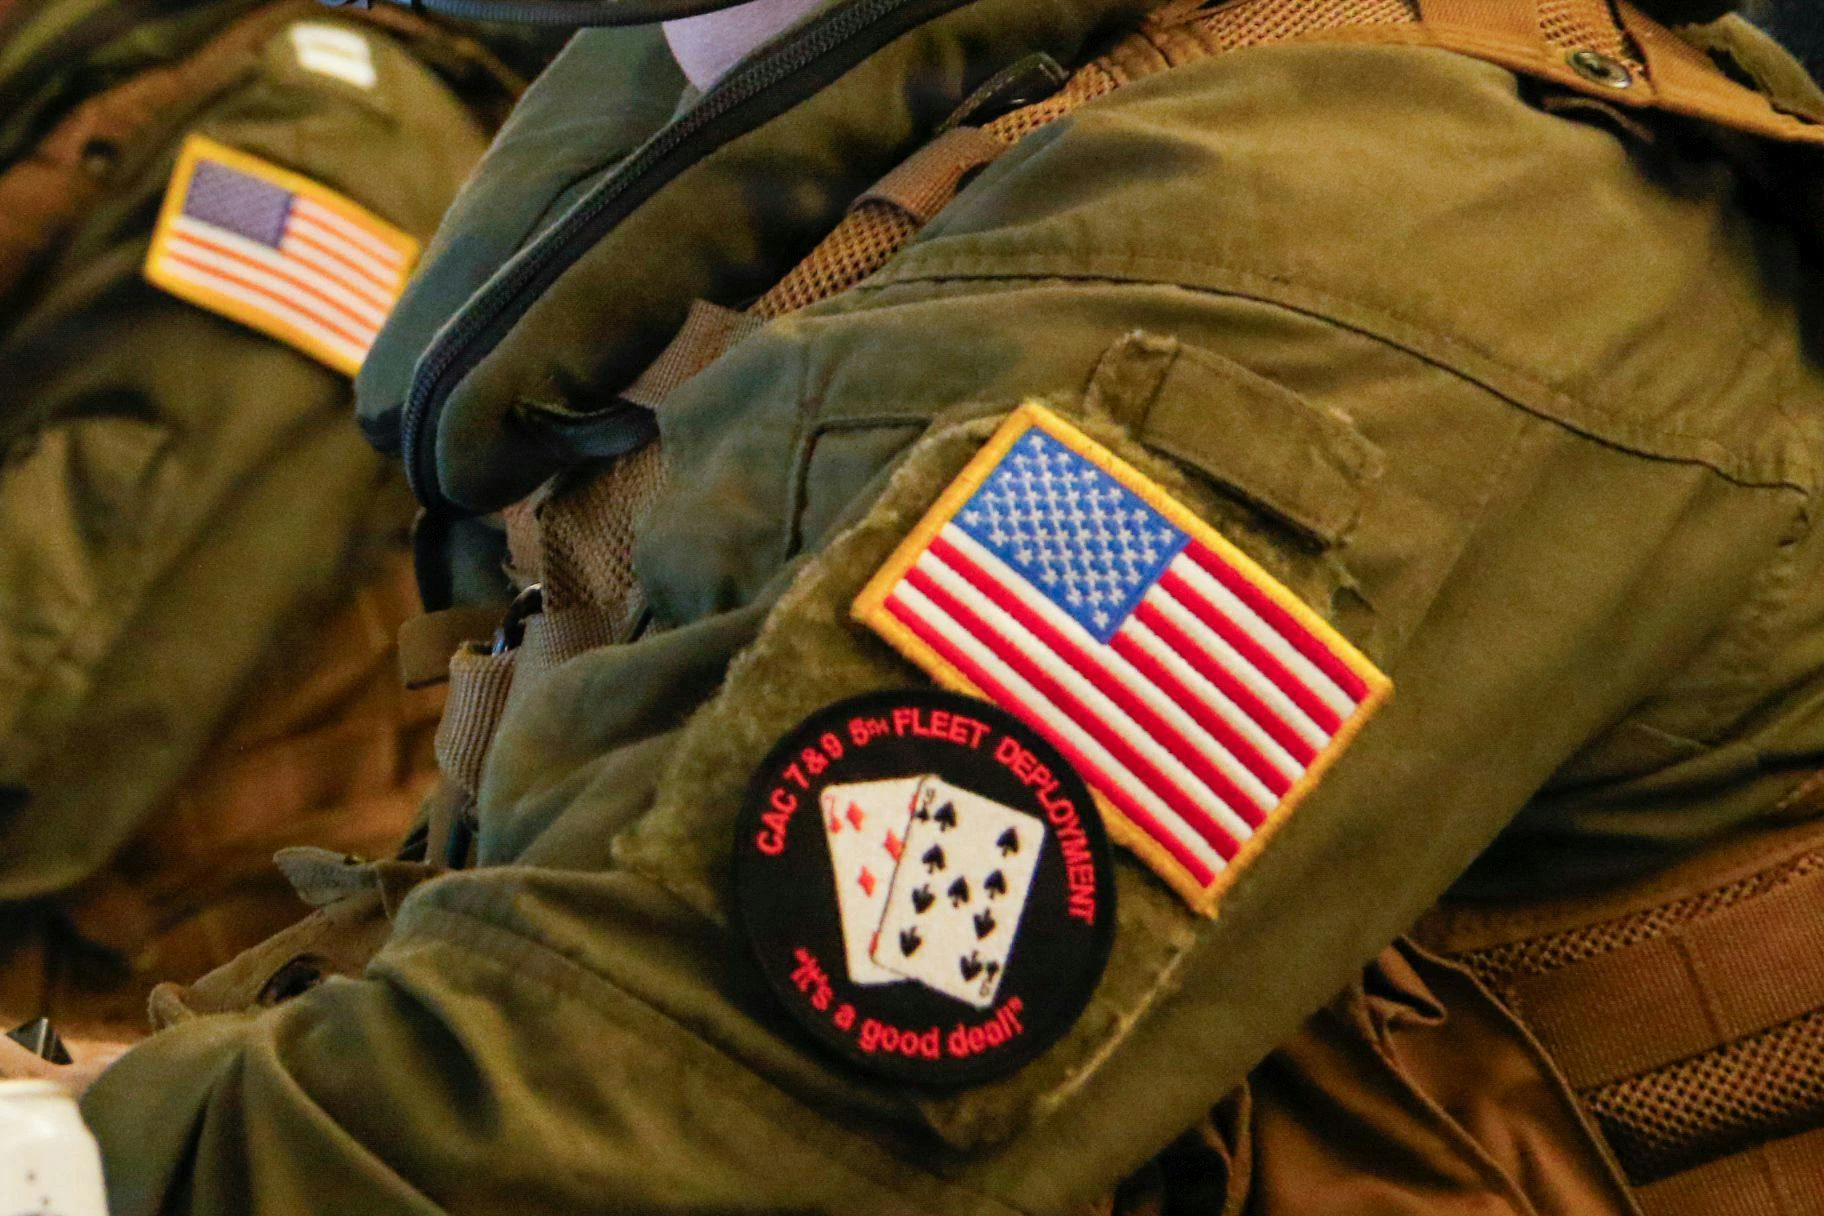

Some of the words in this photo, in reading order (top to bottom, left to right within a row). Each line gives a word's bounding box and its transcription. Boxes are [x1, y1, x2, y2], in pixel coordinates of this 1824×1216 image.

[756, 788, 798, 855] CAC
[892, 706, 992, 749] FLEET
[994, 735, 1097, 926] DEPLOYMENT
[835, 1005, 855, 1029] a
[859, 1019, 940, 1058] good
